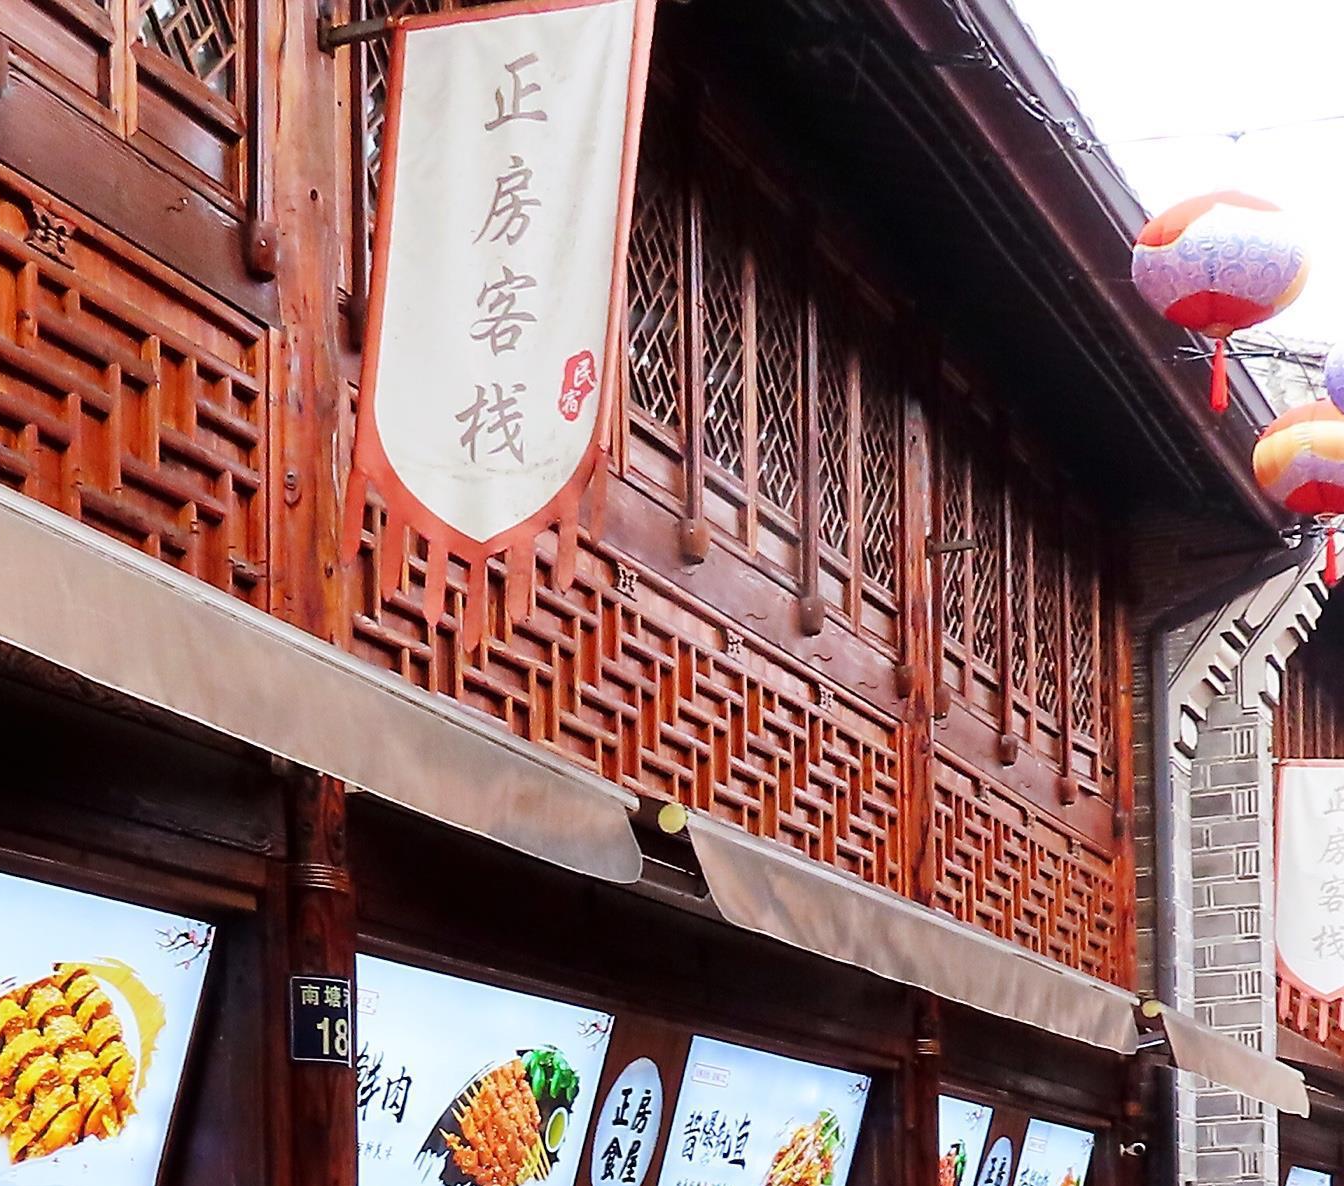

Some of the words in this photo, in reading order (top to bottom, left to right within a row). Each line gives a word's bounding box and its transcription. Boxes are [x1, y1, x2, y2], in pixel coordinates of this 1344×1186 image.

[453, 52, 548, 465] 正房客栈
[612, 1088, 652, 1134] 正房
[600, 1137, 642, 1183] 食屋
